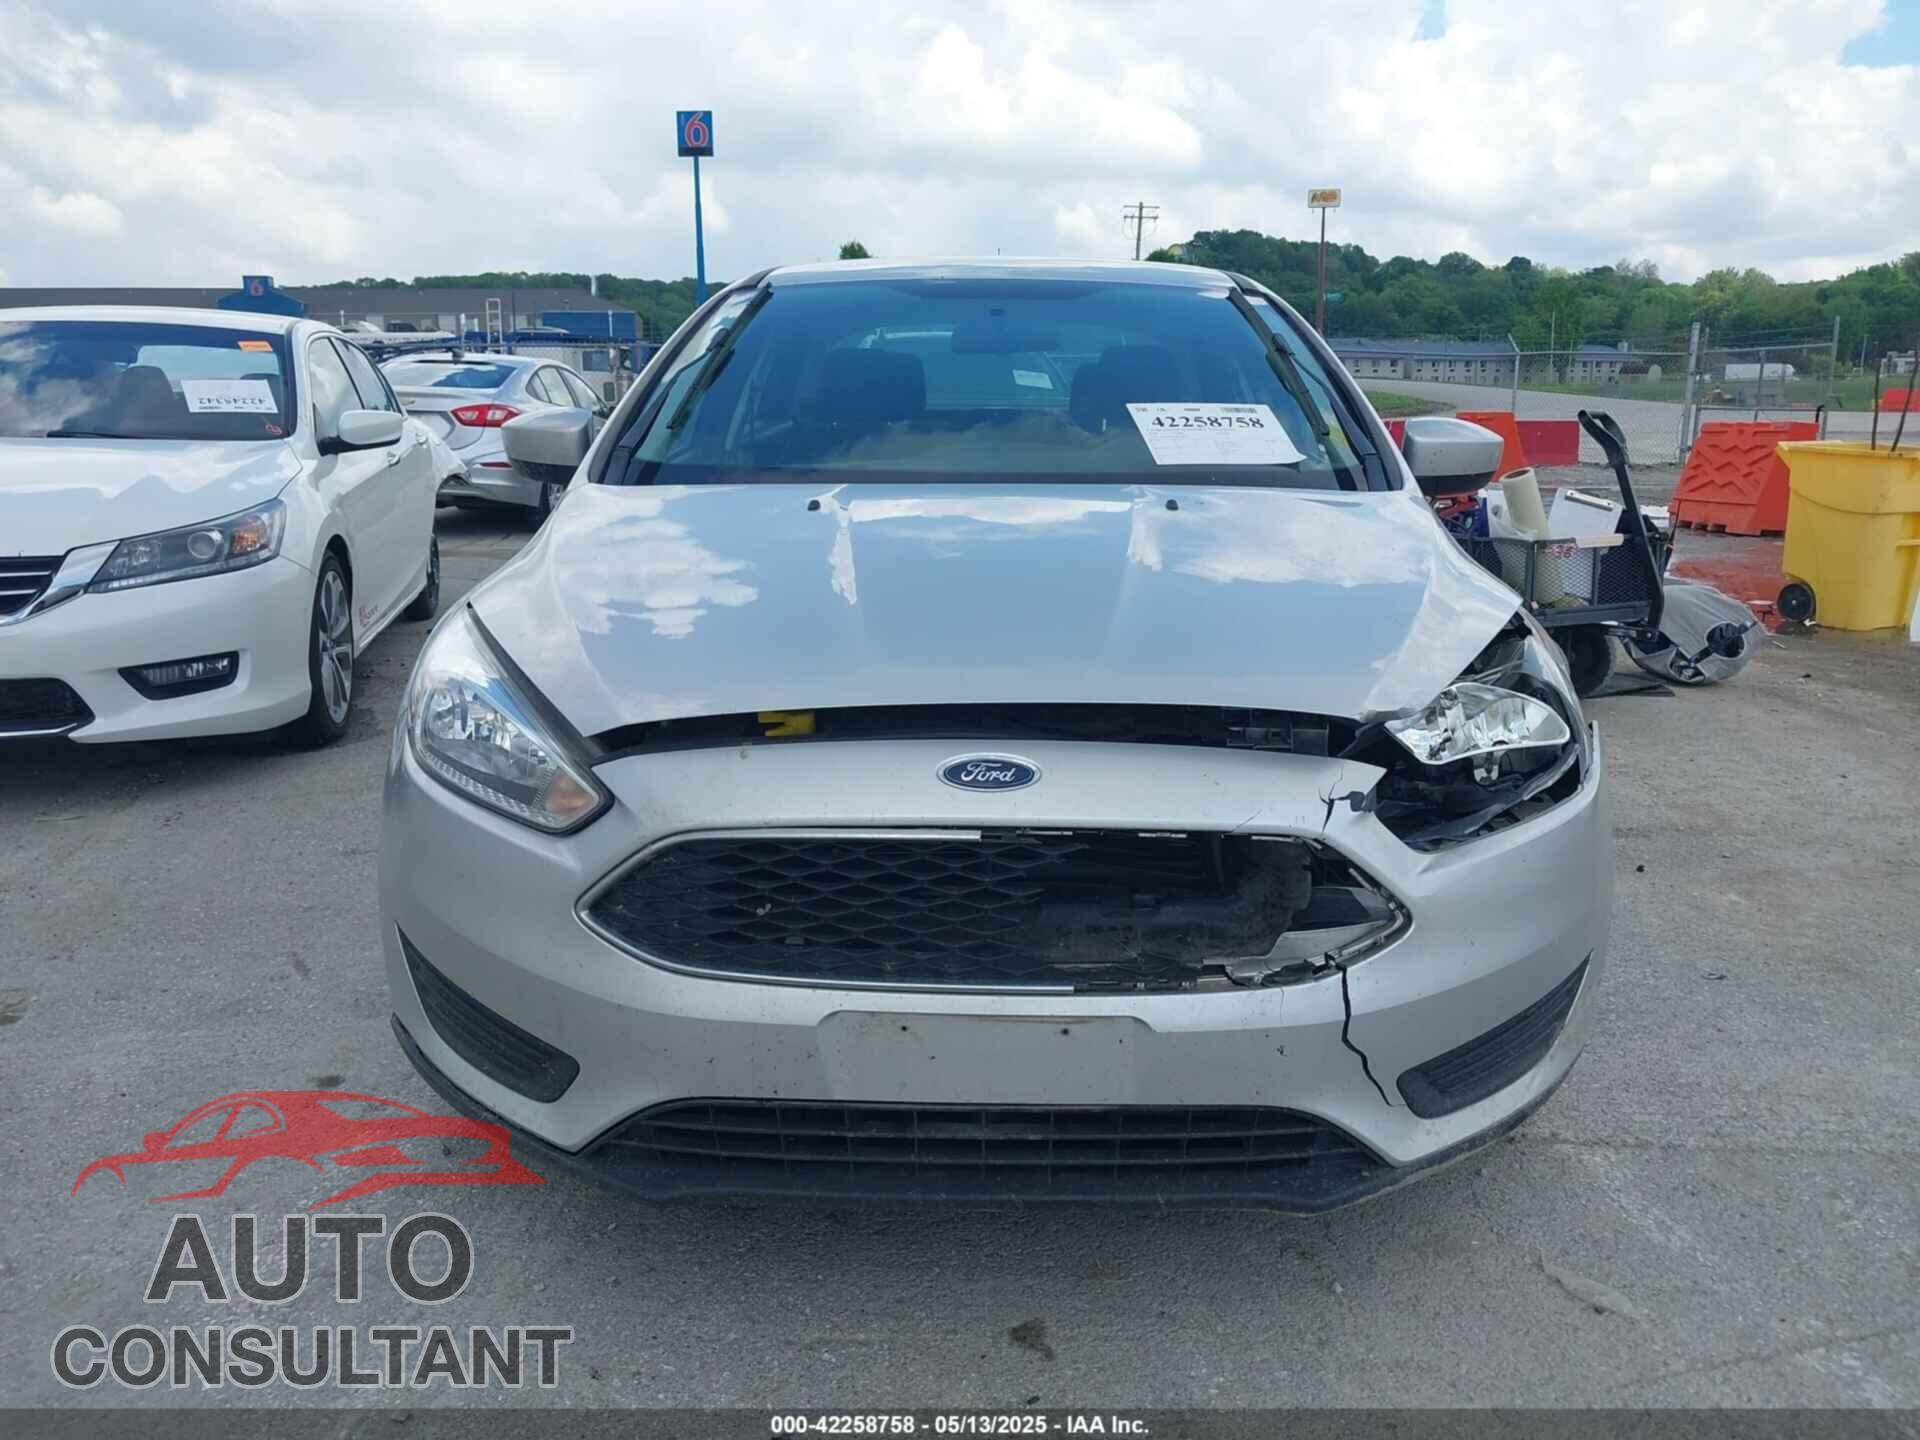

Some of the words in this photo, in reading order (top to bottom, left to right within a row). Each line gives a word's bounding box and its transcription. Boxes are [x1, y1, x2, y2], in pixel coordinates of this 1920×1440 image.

[684, 111, 709, 148] 6
[1152, 416, 1264, 429] 42258758
[961, 761, 1016, 782] Ford
